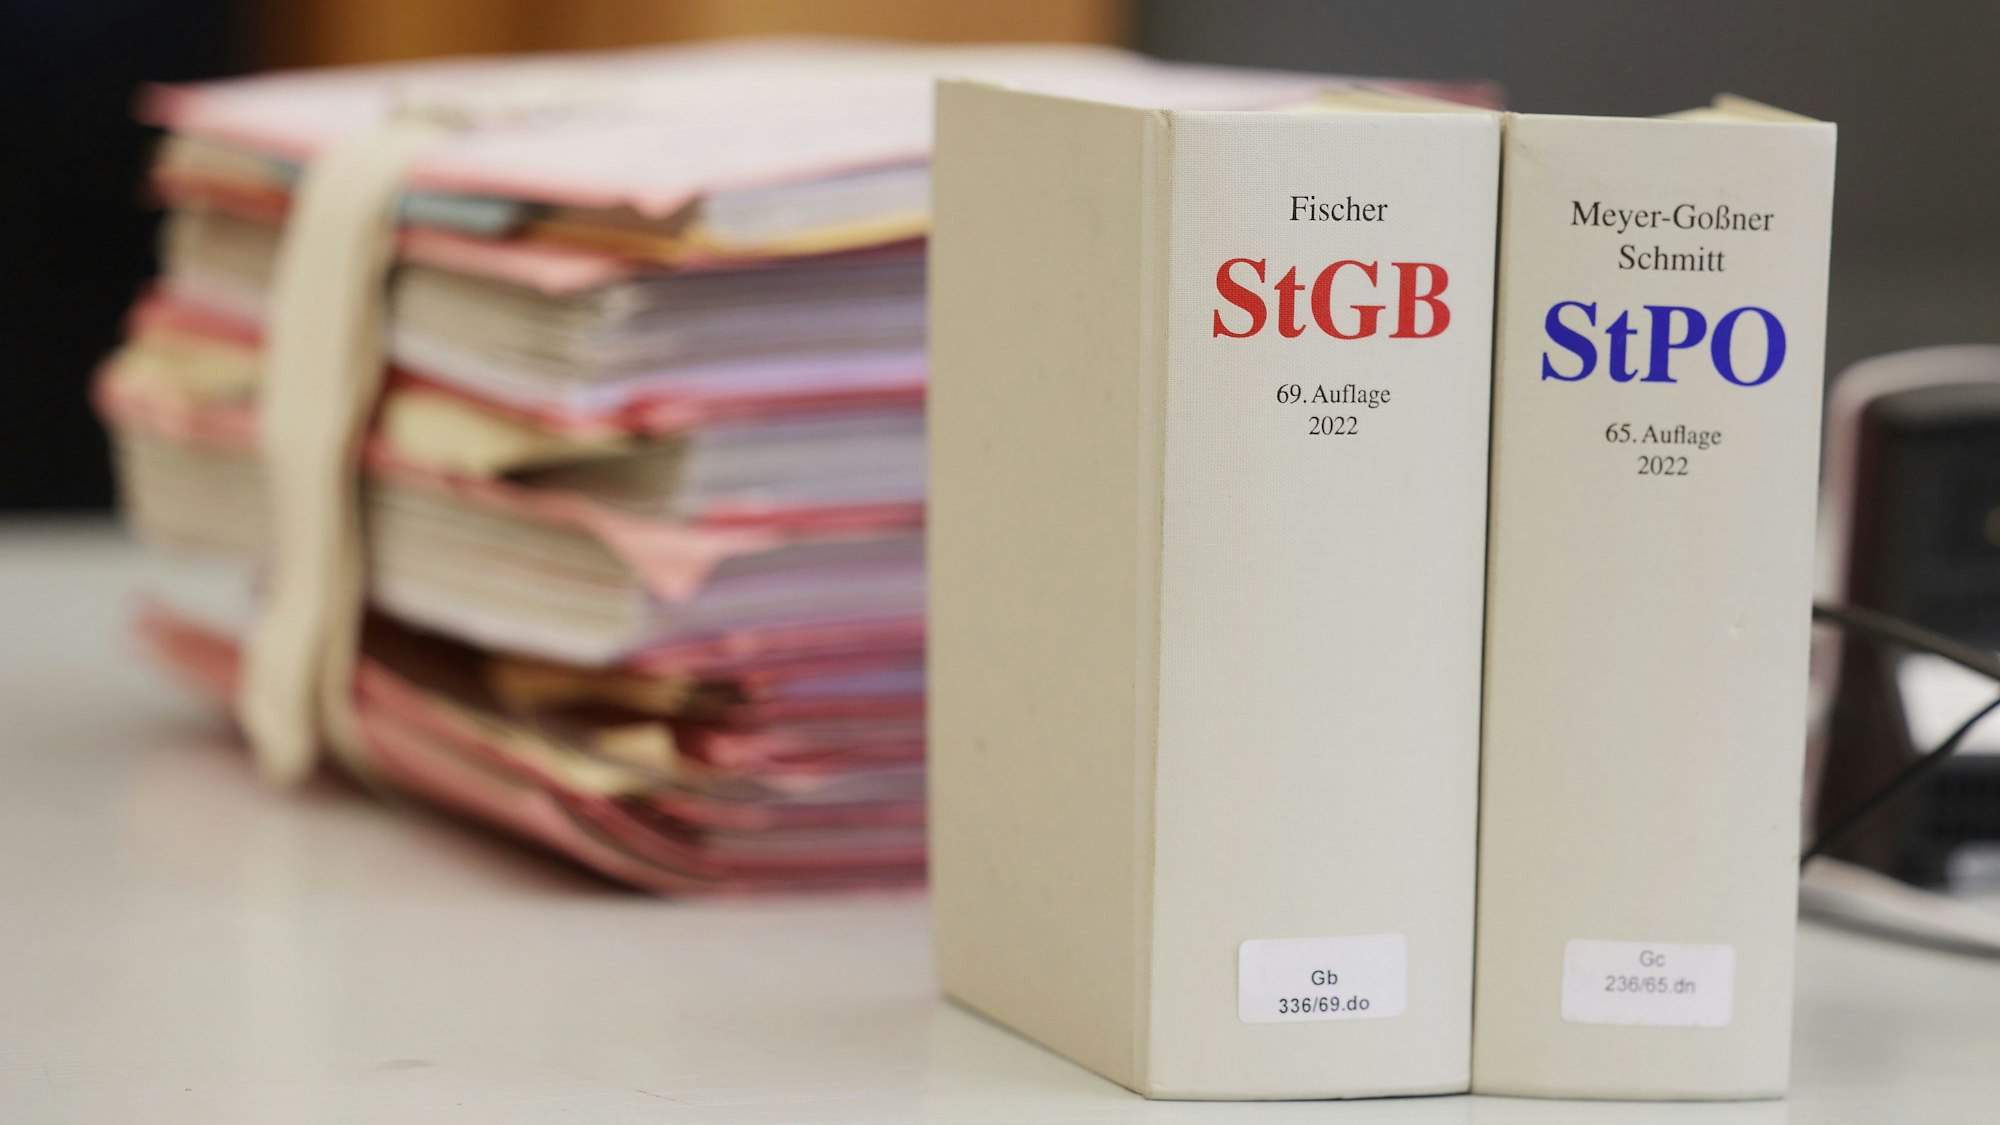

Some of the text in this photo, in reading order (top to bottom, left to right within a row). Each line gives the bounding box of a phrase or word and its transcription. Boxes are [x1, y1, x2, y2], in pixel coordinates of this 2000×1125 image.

[1289, 195, 1389, 222] Fischer
[1570, 200, 1775, 235] Meyer-Goßner
[1617, 244, 1726, 272] Schmitt
[1212, 257, 1451, 341] StGB
[1541, 300, 1788, 388] StPO
[1276, 383, 1392, 409] 69. Auflage
[1308, 415, 1360, 436] 2022
[1605, 422, 1723, 450] 65. Auflage
[1637, 455, 1689, 476] 2022
[1638, 950, 1667, 968] Gc
[1310, 969, 1339, 987] Gb
[1604, 974, 1697, 995] 236/65.dn
[1278, 994, 1371, 1015] 336/69.do
